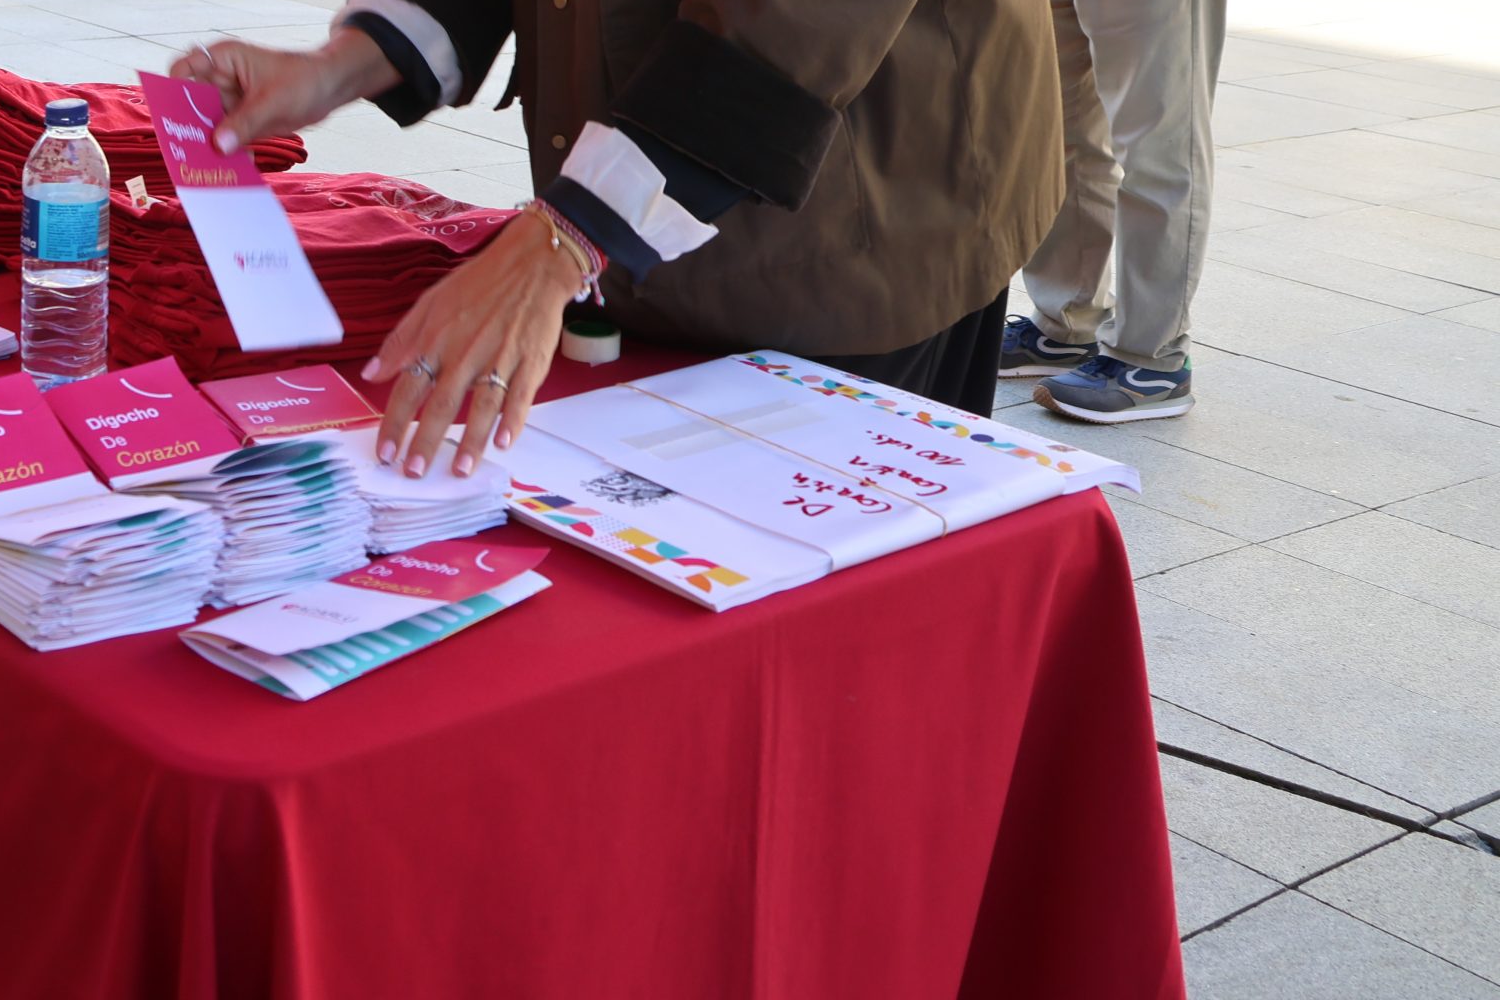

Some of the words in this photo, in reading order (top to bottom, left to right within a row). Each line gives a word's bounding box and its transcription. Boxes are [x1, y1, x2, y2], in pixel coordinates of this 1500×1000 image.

[248, 414, 275, 425] De
[99, 435, 128, 449] De
[115, 440, 201, 467] Corazón
